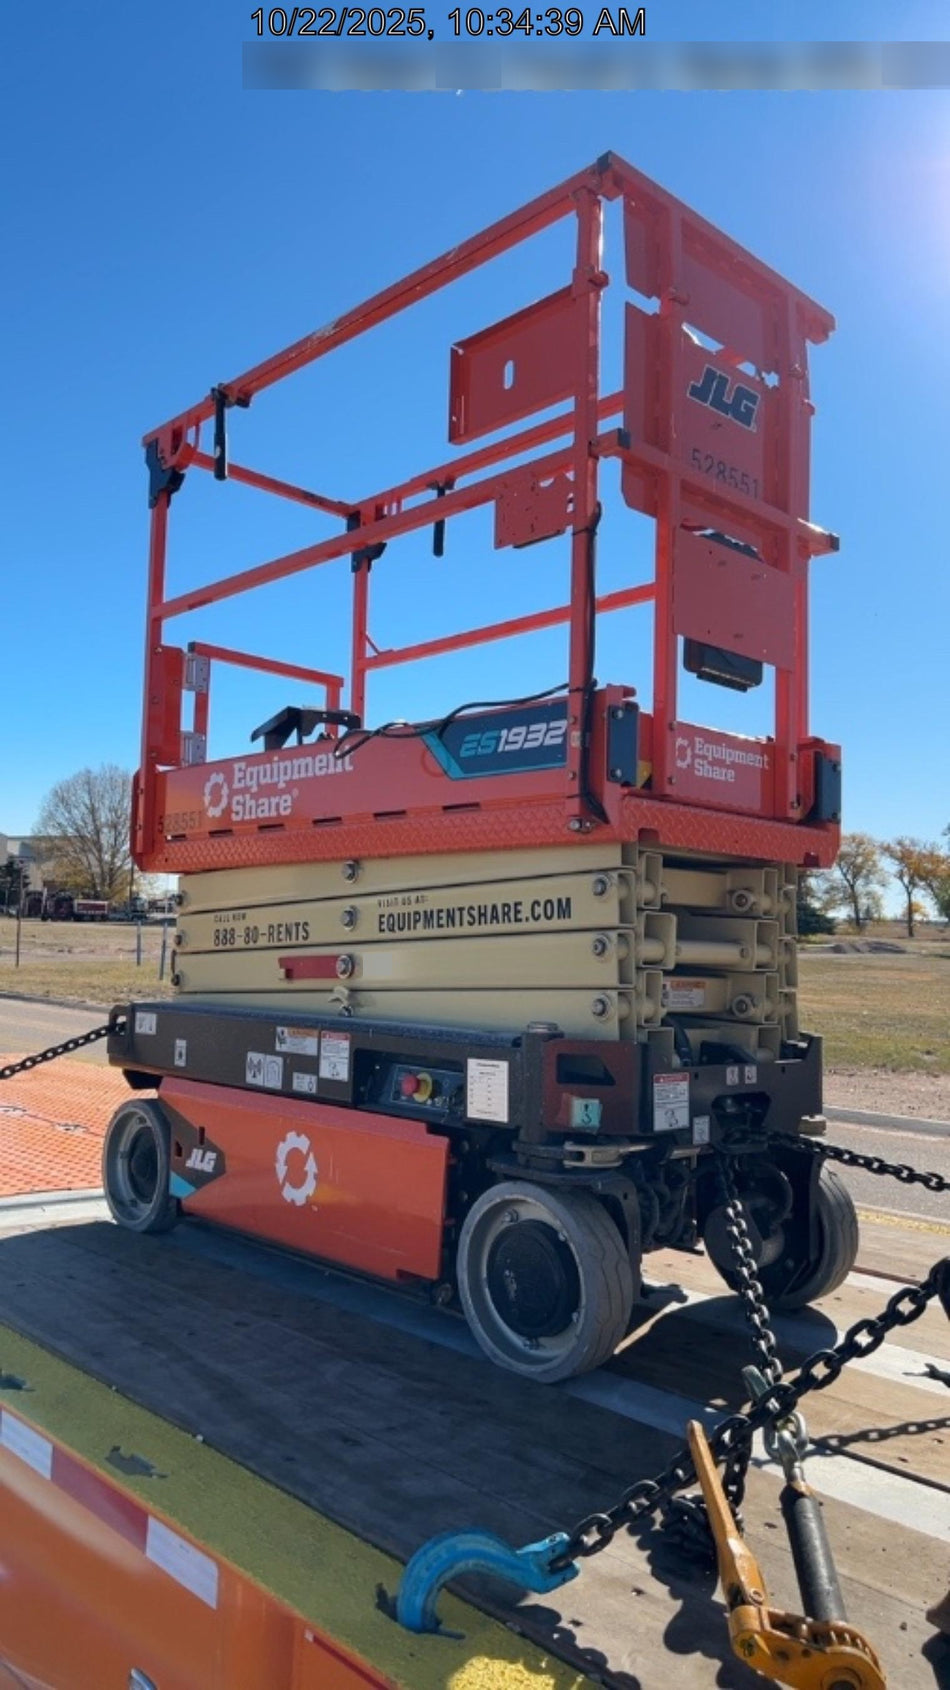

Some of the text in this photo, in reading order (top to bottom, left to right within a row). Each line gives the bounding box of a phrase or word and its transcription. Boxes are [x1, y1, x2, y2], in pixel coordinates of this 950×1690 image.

[687, 364, 760, 432] JLG
[691, 448, 760, 499] 528551
[459, 719, 568, 758] ES1932
[694, 736, 769, 770] Equipment
[231, 746, 354, 793] Equipment
[694, 757, 736, 782] Share
[377, 896, 573, 934] EQUIPMENTSHARE.COM
[401, 896, 412, 906] US
[213, 921, 310, 947] 888-80-RENTS
[185, 1148, 217, 1172] JLG
